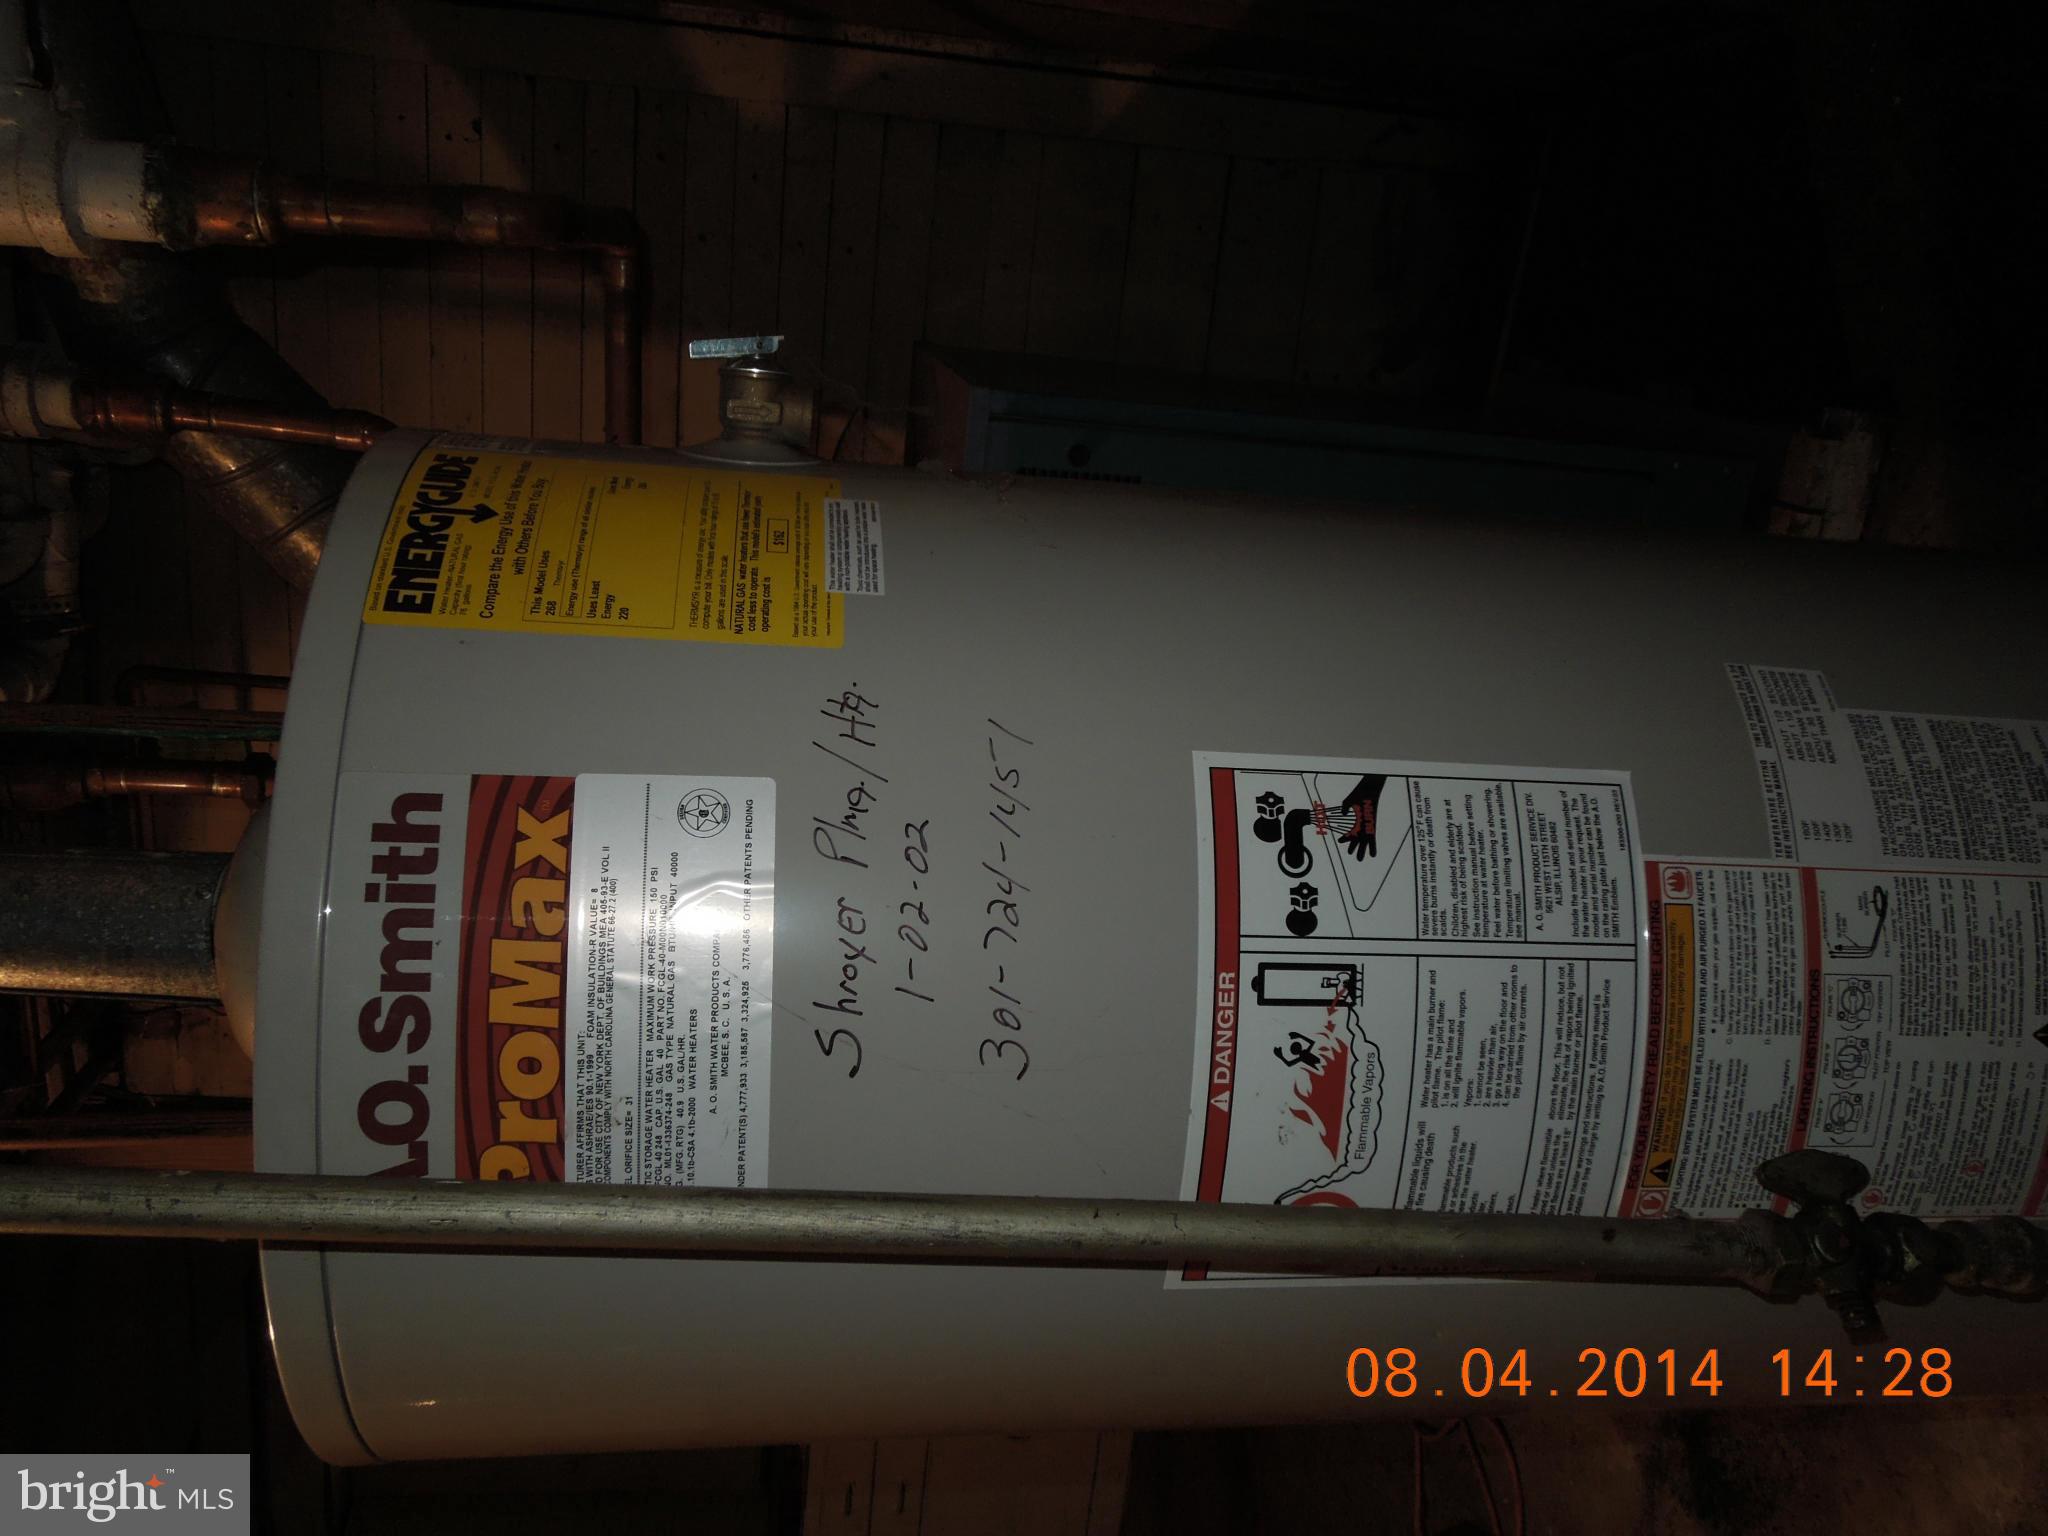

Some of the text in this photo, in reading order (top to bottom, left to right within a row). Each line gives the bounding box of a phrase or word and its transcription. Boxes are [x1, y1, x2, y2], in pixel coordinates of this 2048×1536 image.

[500, 512, 514, 524] Use
[521, 503, 539, 525] Before
[382, 453, 478, 613] ENERGYGUIDE
[492, 527, 512, 555] Energy
[515, 527, 533, 554] Others
[490, 557, 504, 571] the
[512, 557, 527, 575] with
[479, 574, 500, 618] Compare
[530, 550, 551, 615] This Model Uses
[762, 584, 771, 597] cost
[546, 601, 557, 615] 268
[586, 581, 601, 618] Uses Least
[601, 594, 615, 619] Energy
[734, 583, 745, 634] NATURAL GAS
[749, 601, 757, 615] less
[618, 608, 629, 620] 220
[748, 617, 757, 631] cost
[761, 599, 772, 632] operating
[1770, 761, 1781, 789] MANUAL
[1413, 781, 1422, 802] cause
[745, 799, 754, 839] PENDING
[1759, 760, 1783, 858] TEMPERATURE SETTING
[1776, 792, 1790, 841] INSTRUCTION
[1425, 817, 1433, 837] death
[1537, 812, 1548, 842] STREET
[601, 854, 610, 873] VOL
[670, 852, 679, 877] 40000
[744, 843, 753, 885] PATENTS
[1525, 792, 1543, 911] SMITH PRODUCT SERVICE DIV.
[1542, 845, 1550, 868] 115TH
[1551, 846, 1561, 878] ILLINOIS
[1428, 850, 1437, 883] instantly
[600, 877, 609, 914] 405-93-E
[609, 878, 618, 896] (400)
[1421, 864, 1430, 911] temperature
[1543, 871, 1552, 894] WEST
[743, 888, 752, 920] OTHER
[1429, 886, 1438, 908] burns
[358, 793, 443, 1054] Smith
[589, 899, 598, 936] VALUE=
[894, 820, 935, 1003] 1-02-02
[600, 918, 608, 938] MEA
[608, 927, 617, 962] STATUTE
[588, 939, 598, 1007] INSULATION-R
[599, 942, 608, 993] BUILDINGS
[668, 961, 676, 980] GAS
[607, 965, 616, 1004] GENERAL
[711, 970, 719, 1022] PRODUCTS
[599, 997, 607, 1009] OF
[667, 984, 676, 1029] NATURAL
[741, 981, 750, 1022] 3,324,925
[1428, 987, 1436, 1013] burner
[588, 1010, 596, 1038] FOAM
[606, 1007, 615, 1047] CAROLINA
[645, 867, 658, 1168] STORAGE WATER HEATER MAXIMUM WORK PRESSURE 150 PSI
[1214, 972, 1236, 1084] DANGER
[1427, 1016, 1435, 1035] main
[597, 1044, 606, 1069] YORK
[667, 1035, 675, 1059] TYPE
[1425, 1044, 1433, 1058] has
[1626, 899, 1662, 1190] FOR YOUR SAFETY READ BEFORE LIGHTING
[1795, 968, 1820, 1132] LIGHTING INSTRUCTIONS
[587, 1055, 595, 1095] 90.1-1999
[606, 1050, 614, 1077] NORTH
[666, 1063, 674, 1082] GAS
[710, 1062, 718, 1090] SMITH
[1423, 1060, 1432, 1084] heater
[597, 1073, 605, 1094] NEW
[605, 1079, 613, 1099] WITH
[739, 1073, 748, 1112] 4,777,933
[1421, 1087, 1430, 1108] Water
[597, 1098, 604, 1109] OF
[605, 1101, 613, 1133] COMPLY
[1355, 1052, 1376, 1159] Flammable Vapors
[577, 1111, 585, 1149] AFFIRMS
[586, 1098, 595, 1152] ASHRAE/IES
[596, 1112, 604, 1134] CITY
[738, 1115, 747, 1161] PATENT(S)
[586, 1155, 594, 1177] WITH
[595, 1157, 603, 1174] FOR
